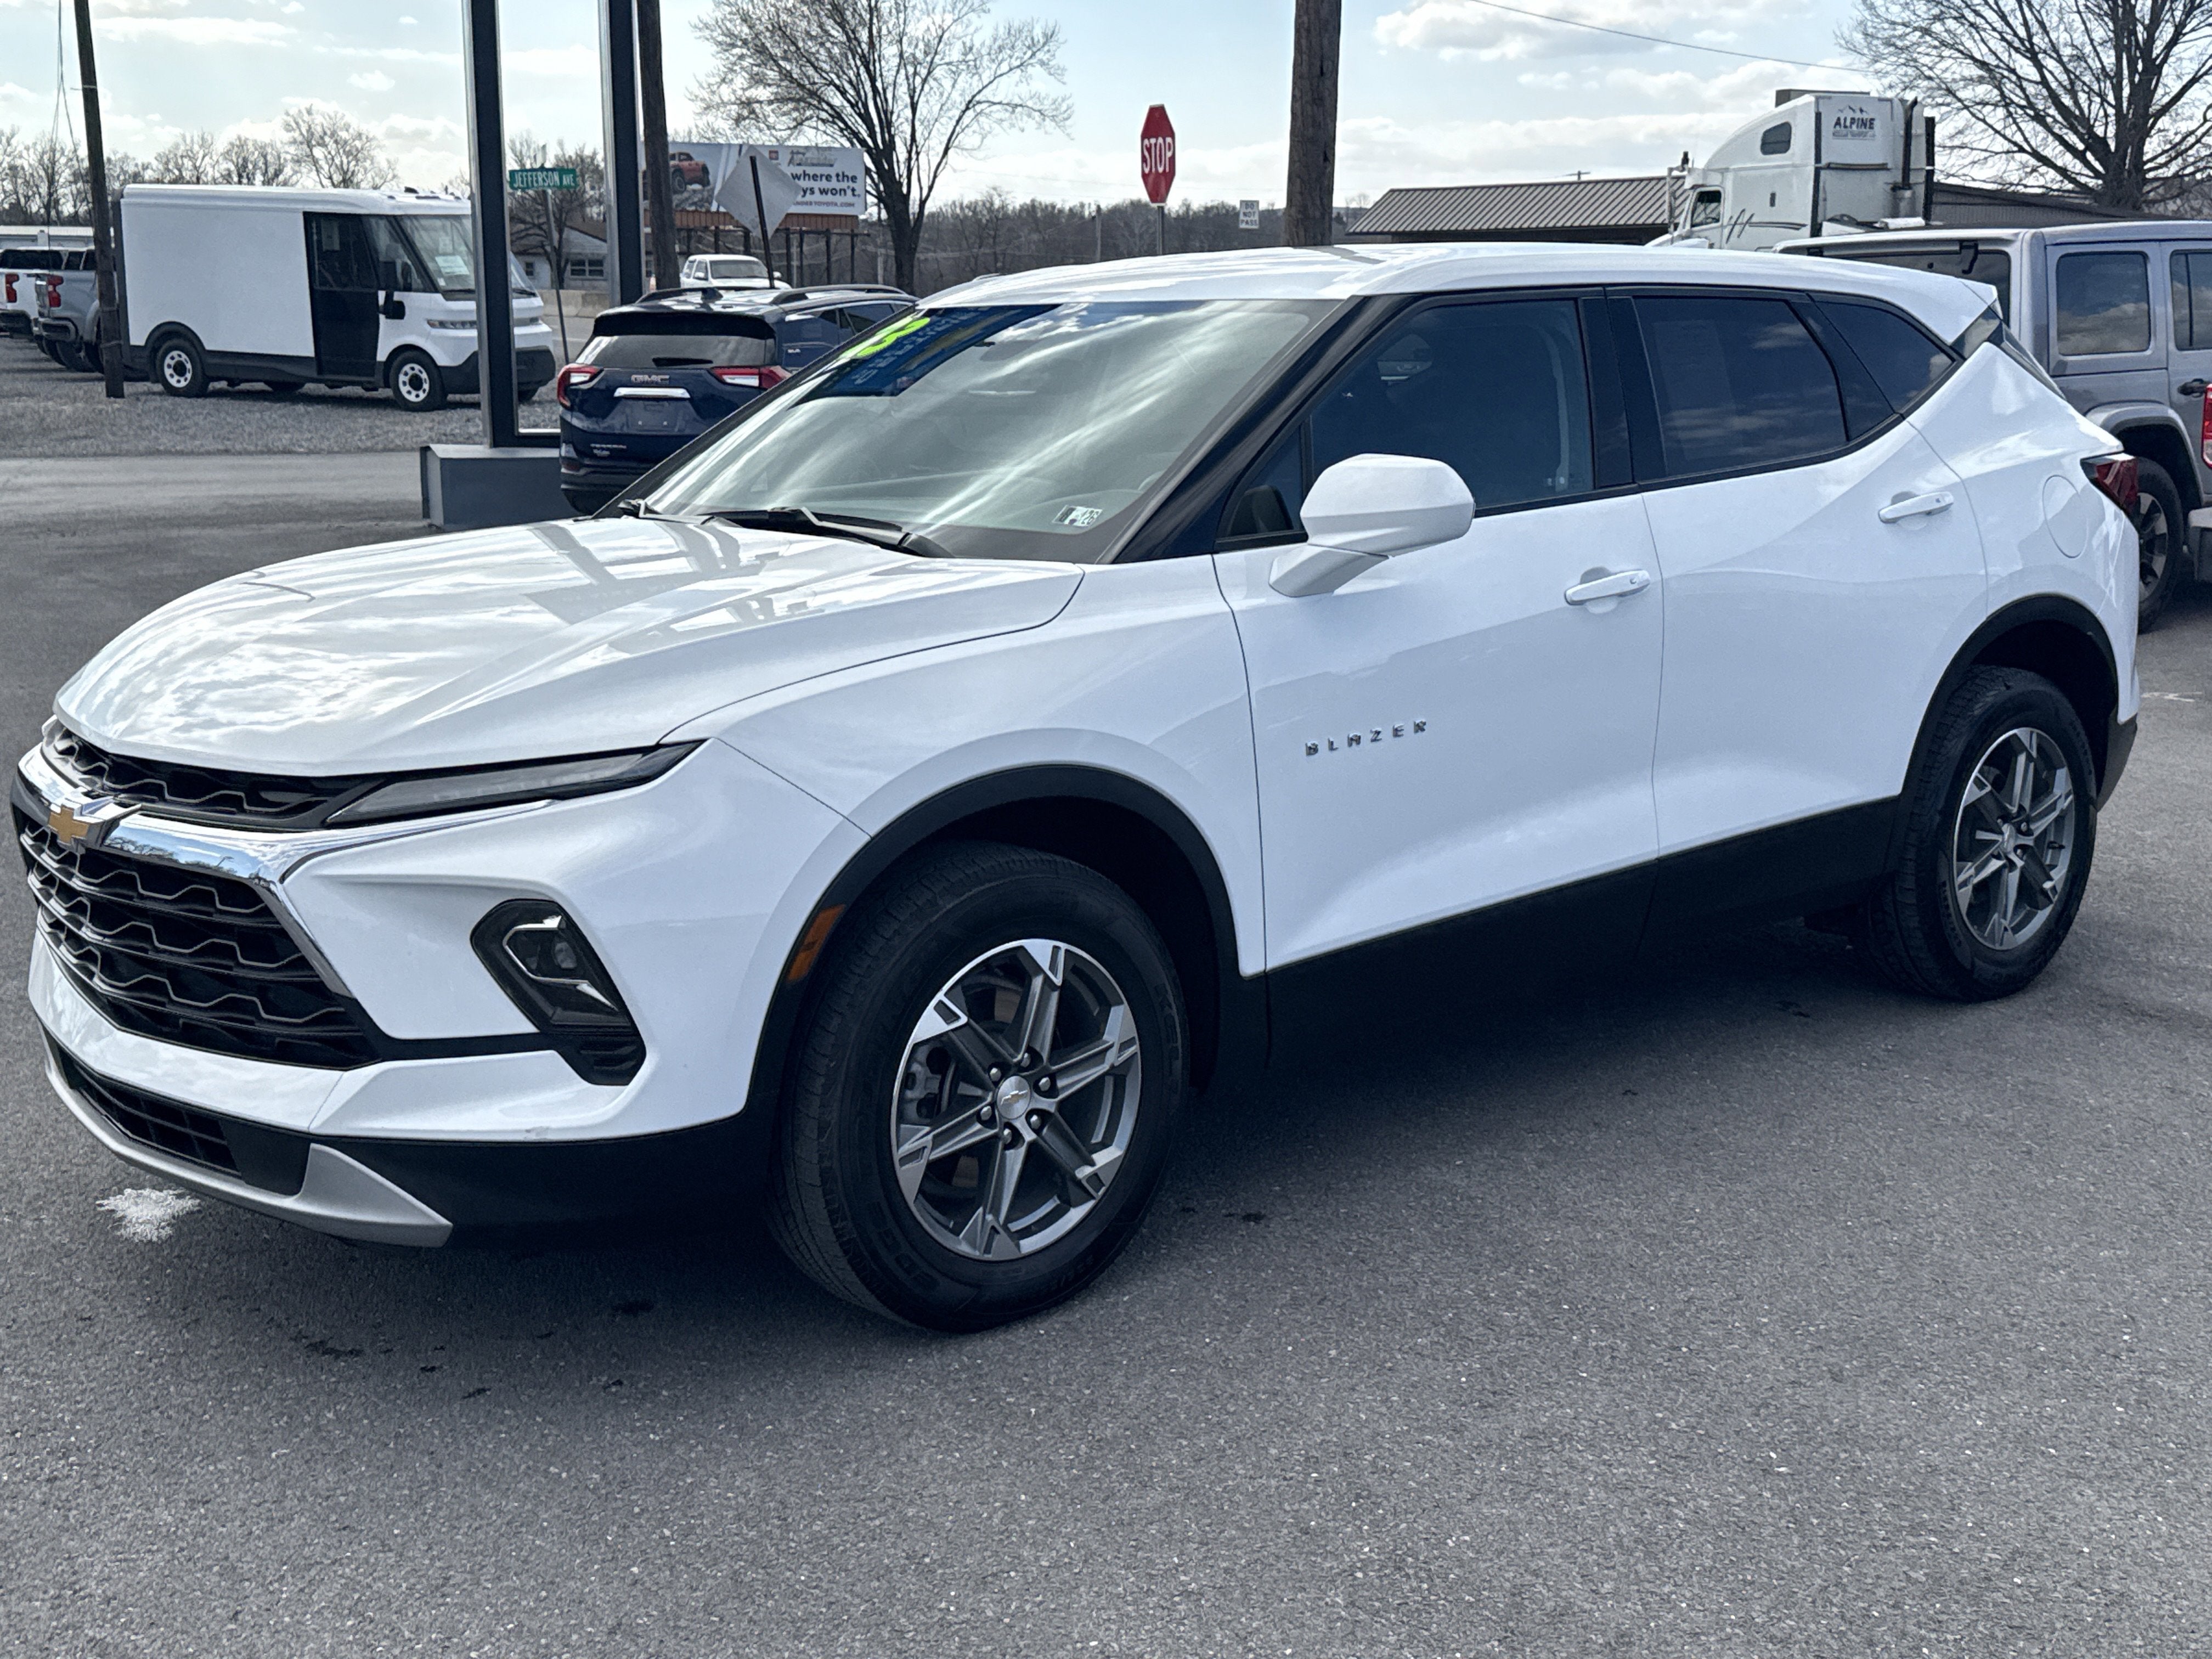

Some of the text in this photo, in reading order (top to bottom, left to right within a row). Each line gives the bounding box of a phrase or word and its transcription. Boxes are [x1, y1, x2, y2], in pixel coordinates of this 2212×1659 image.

[1833, 116, 1875, 129] ALPINE
[1143, 137, 1173, 174] STOP
[514, 171, 575, 187] JEFFERSON AVE
[791, 170, 858, 183] where the
[801, 187, 815, 198] ys
[631, 375, 670, 383] GMC
[1305, 719, 1427, 756] BLAZER
